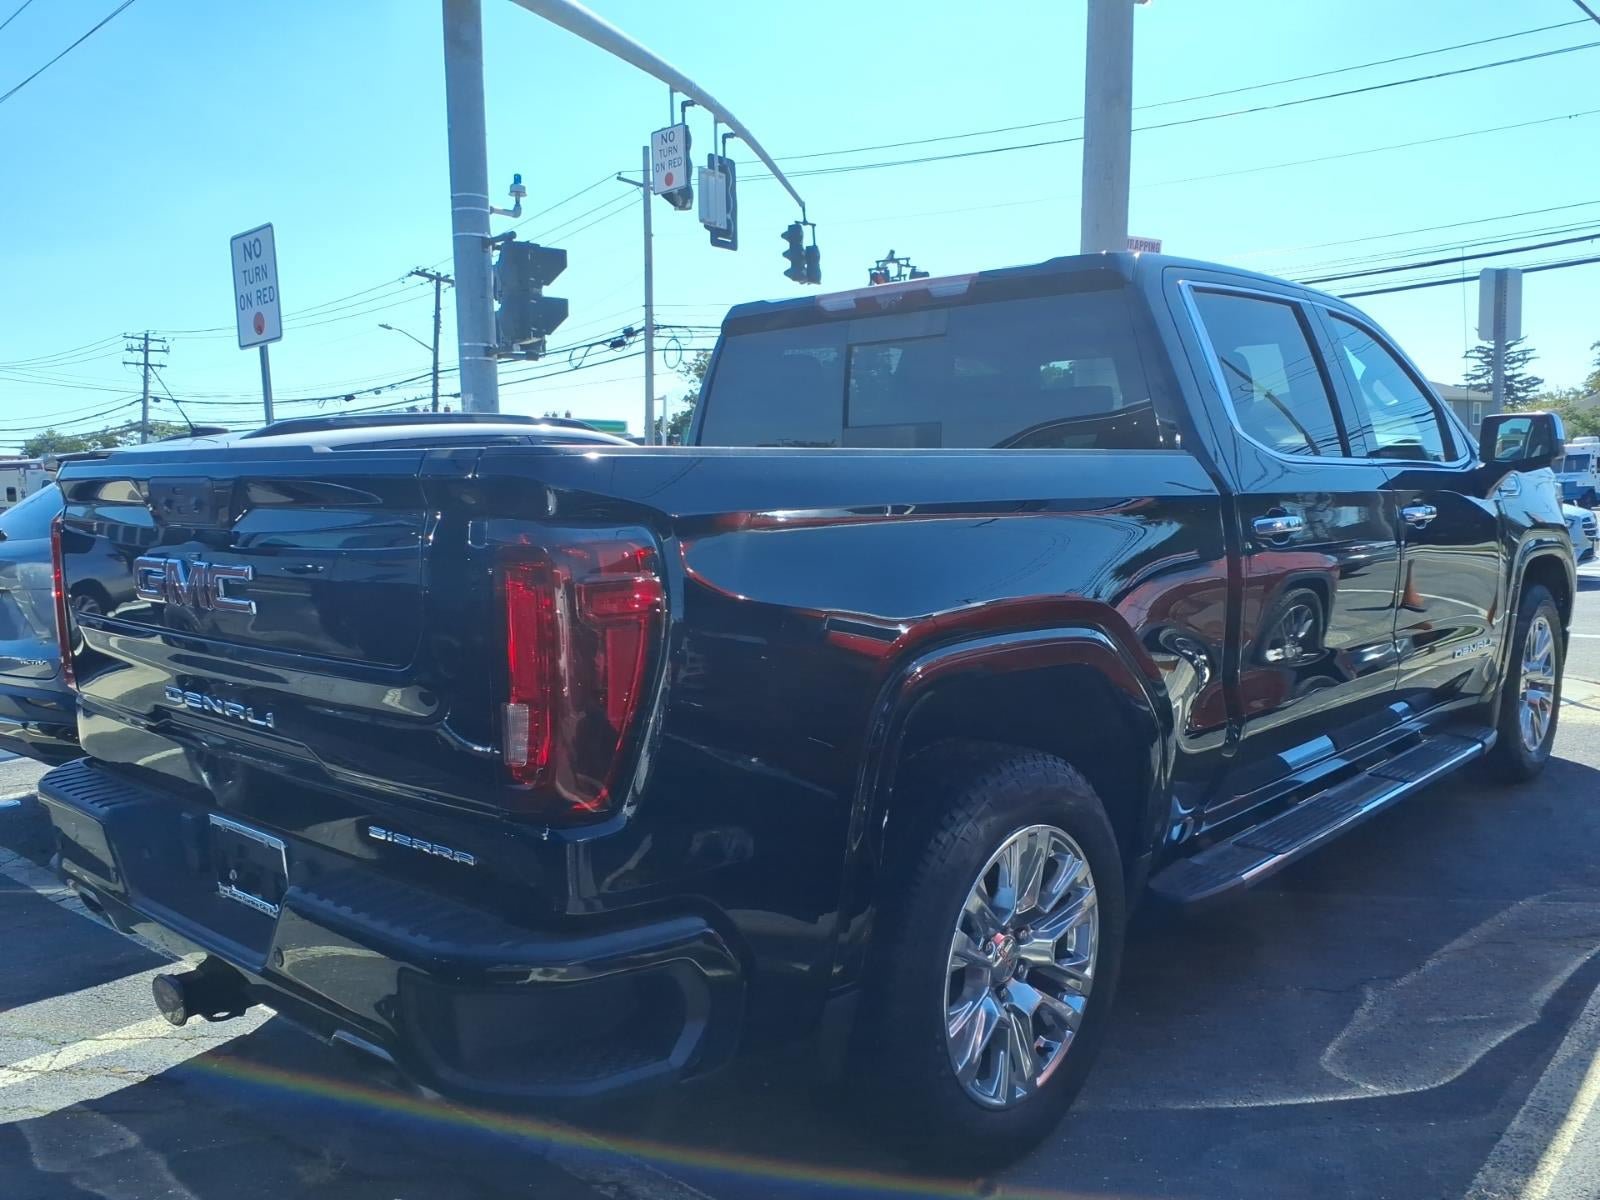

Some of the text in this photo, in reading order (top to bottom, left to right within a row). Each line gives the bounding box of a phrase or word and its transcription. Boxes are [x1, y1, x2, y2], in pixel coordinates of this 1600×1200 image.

[661, 131, 675, 145] NO
[659, 145, 678, 159] TURN
[656, 157, 682, 173] ON RED
[243, 238, 262, 262] NO
[242, 264, 268, 286] TURN
[240, 286, 275, 311] ON RED
[133, 556, 257, 615] GMC
[165, 685, 275, 729] DENALI
[368, 825, 476, 867] SIERRA
